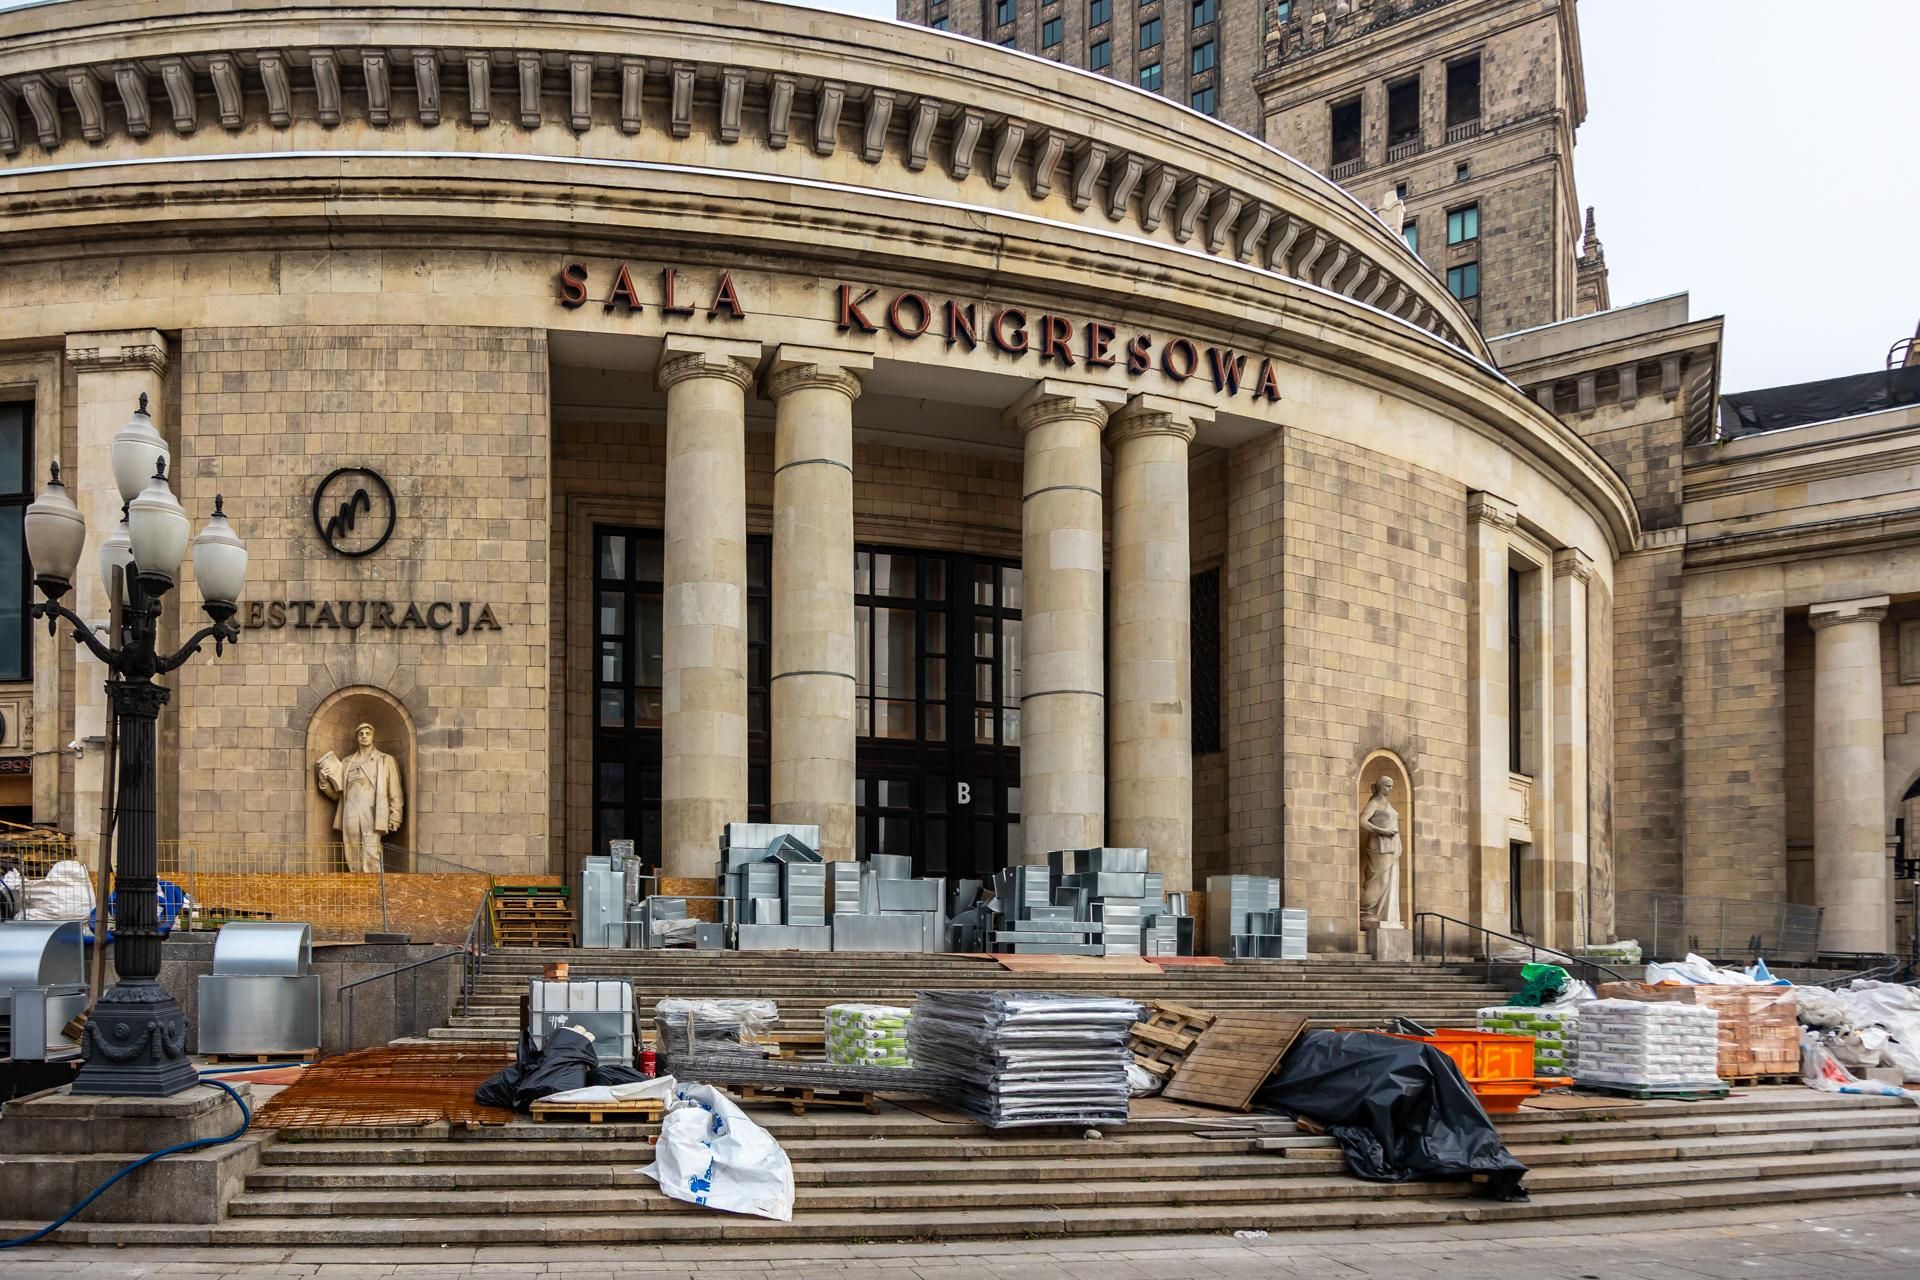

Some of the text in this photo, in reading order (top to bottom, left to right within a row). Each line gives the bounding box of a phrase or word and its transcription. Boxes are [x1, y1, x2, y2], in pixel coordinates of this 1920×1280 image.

[561, 261, 1282, 401] SALA KONGRESOWA
[228, 600, 502, 636] ESTAURACJA
[957, 782, 971, 804] B
